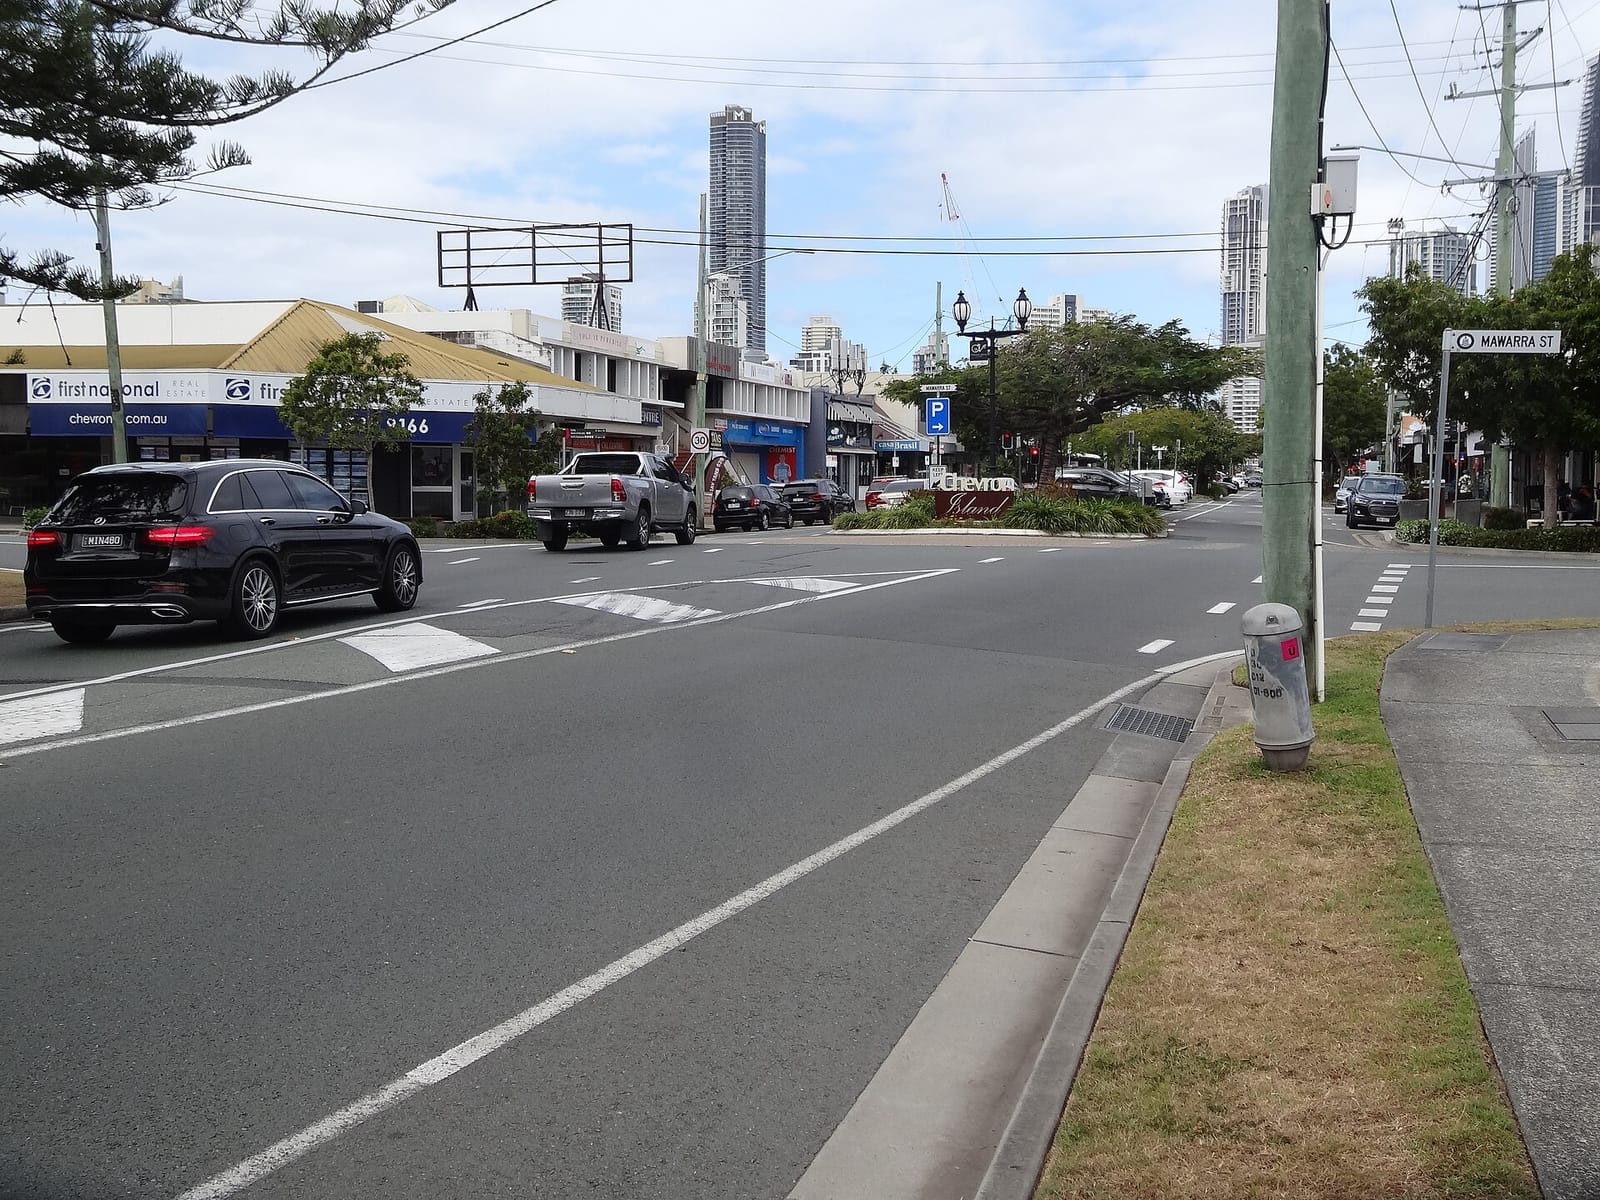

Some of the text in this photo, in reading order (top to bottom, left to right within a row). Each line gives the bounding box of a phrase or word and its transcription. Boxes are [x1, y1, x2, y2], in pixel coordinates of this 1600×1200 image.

[1481, 335, 1554, 348] MAWARRA ST
[89, 380, 159, 397] naonal
[172, 379, 200, 388] REAL
[426, 398, 469, 407] ESTATE
[931, 401, 944, 418] P
[694, 436, 706, 445] 30
[878, 441, 894, 449] casa
[939, 472, 1015, 492] Chevron
[944, 492, 1010, 515] Island
[1288, 646, 1296, 656] U
